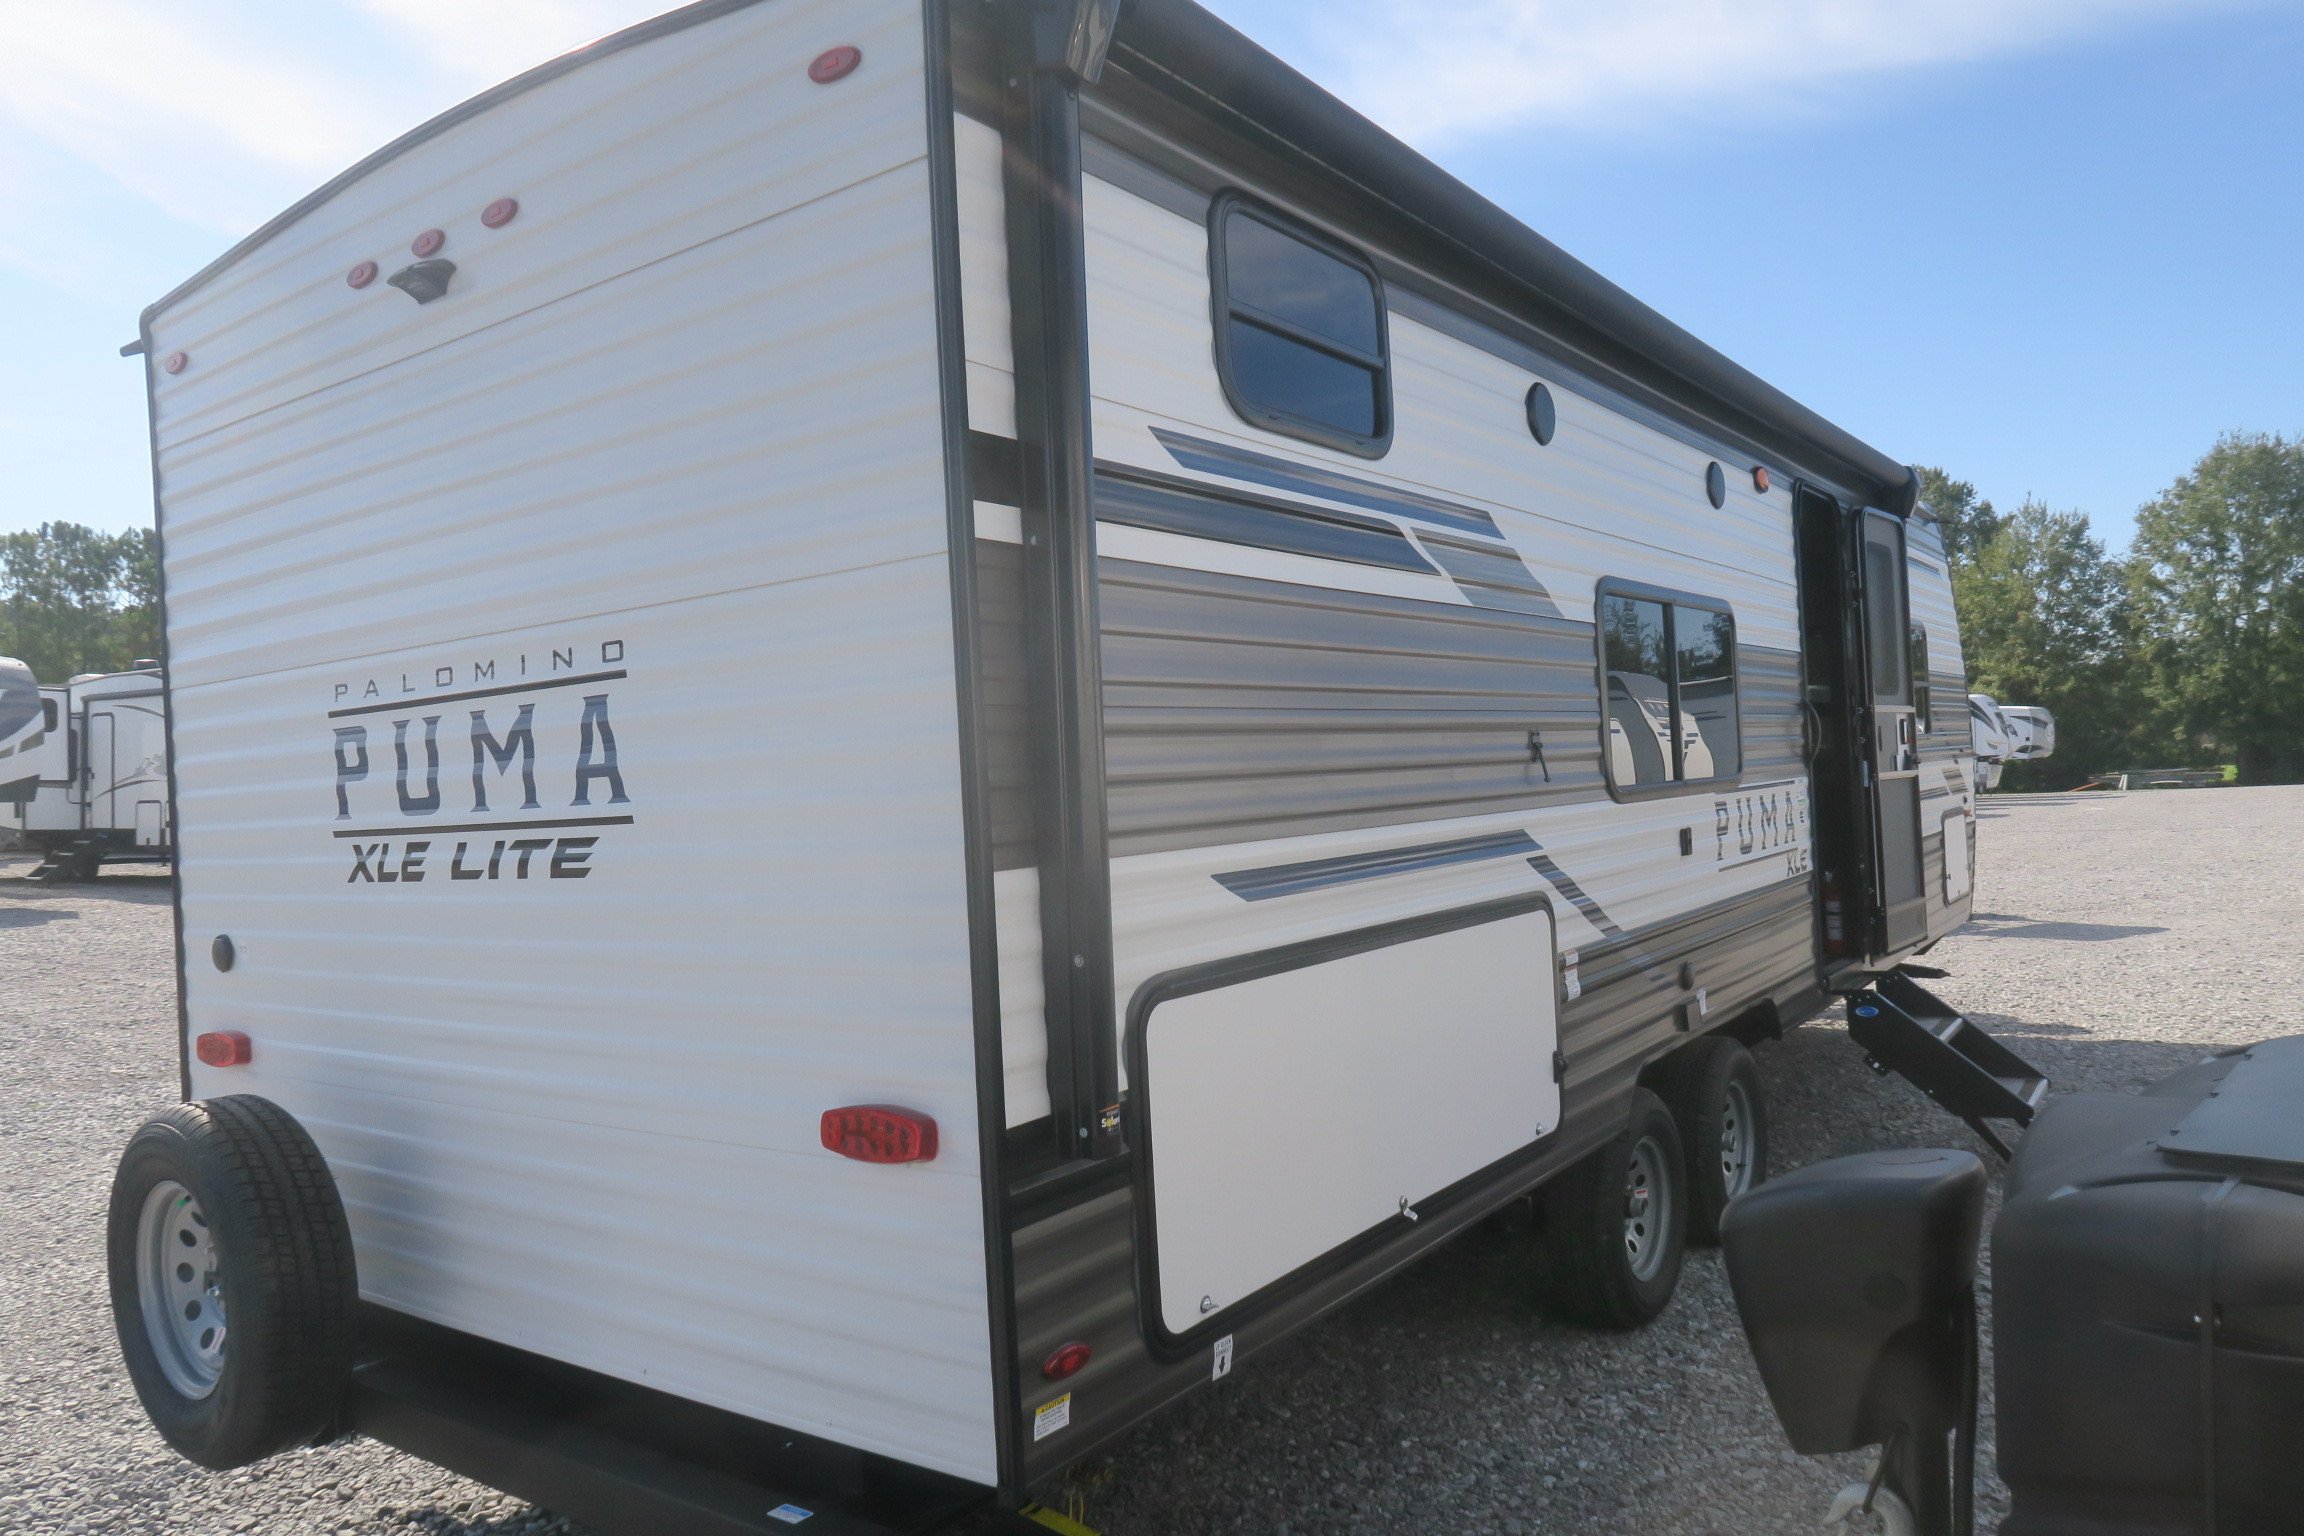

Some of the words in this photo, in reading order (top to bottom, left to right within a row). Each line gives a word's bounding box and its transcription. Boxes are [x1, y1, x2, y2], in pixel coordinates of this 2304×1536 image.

[335, 640, 624, 702] PALOMINO
[333, 694, 631, 820] PUMA
[1714, 791, 1796, 861] PUMA
[348, 841, 431, 883] XLE
[451, 837, 600, 880] LITE
[1787, 848, 1808, 877] XLE
[1044, 1396, 1065, 1411] CAUTION
